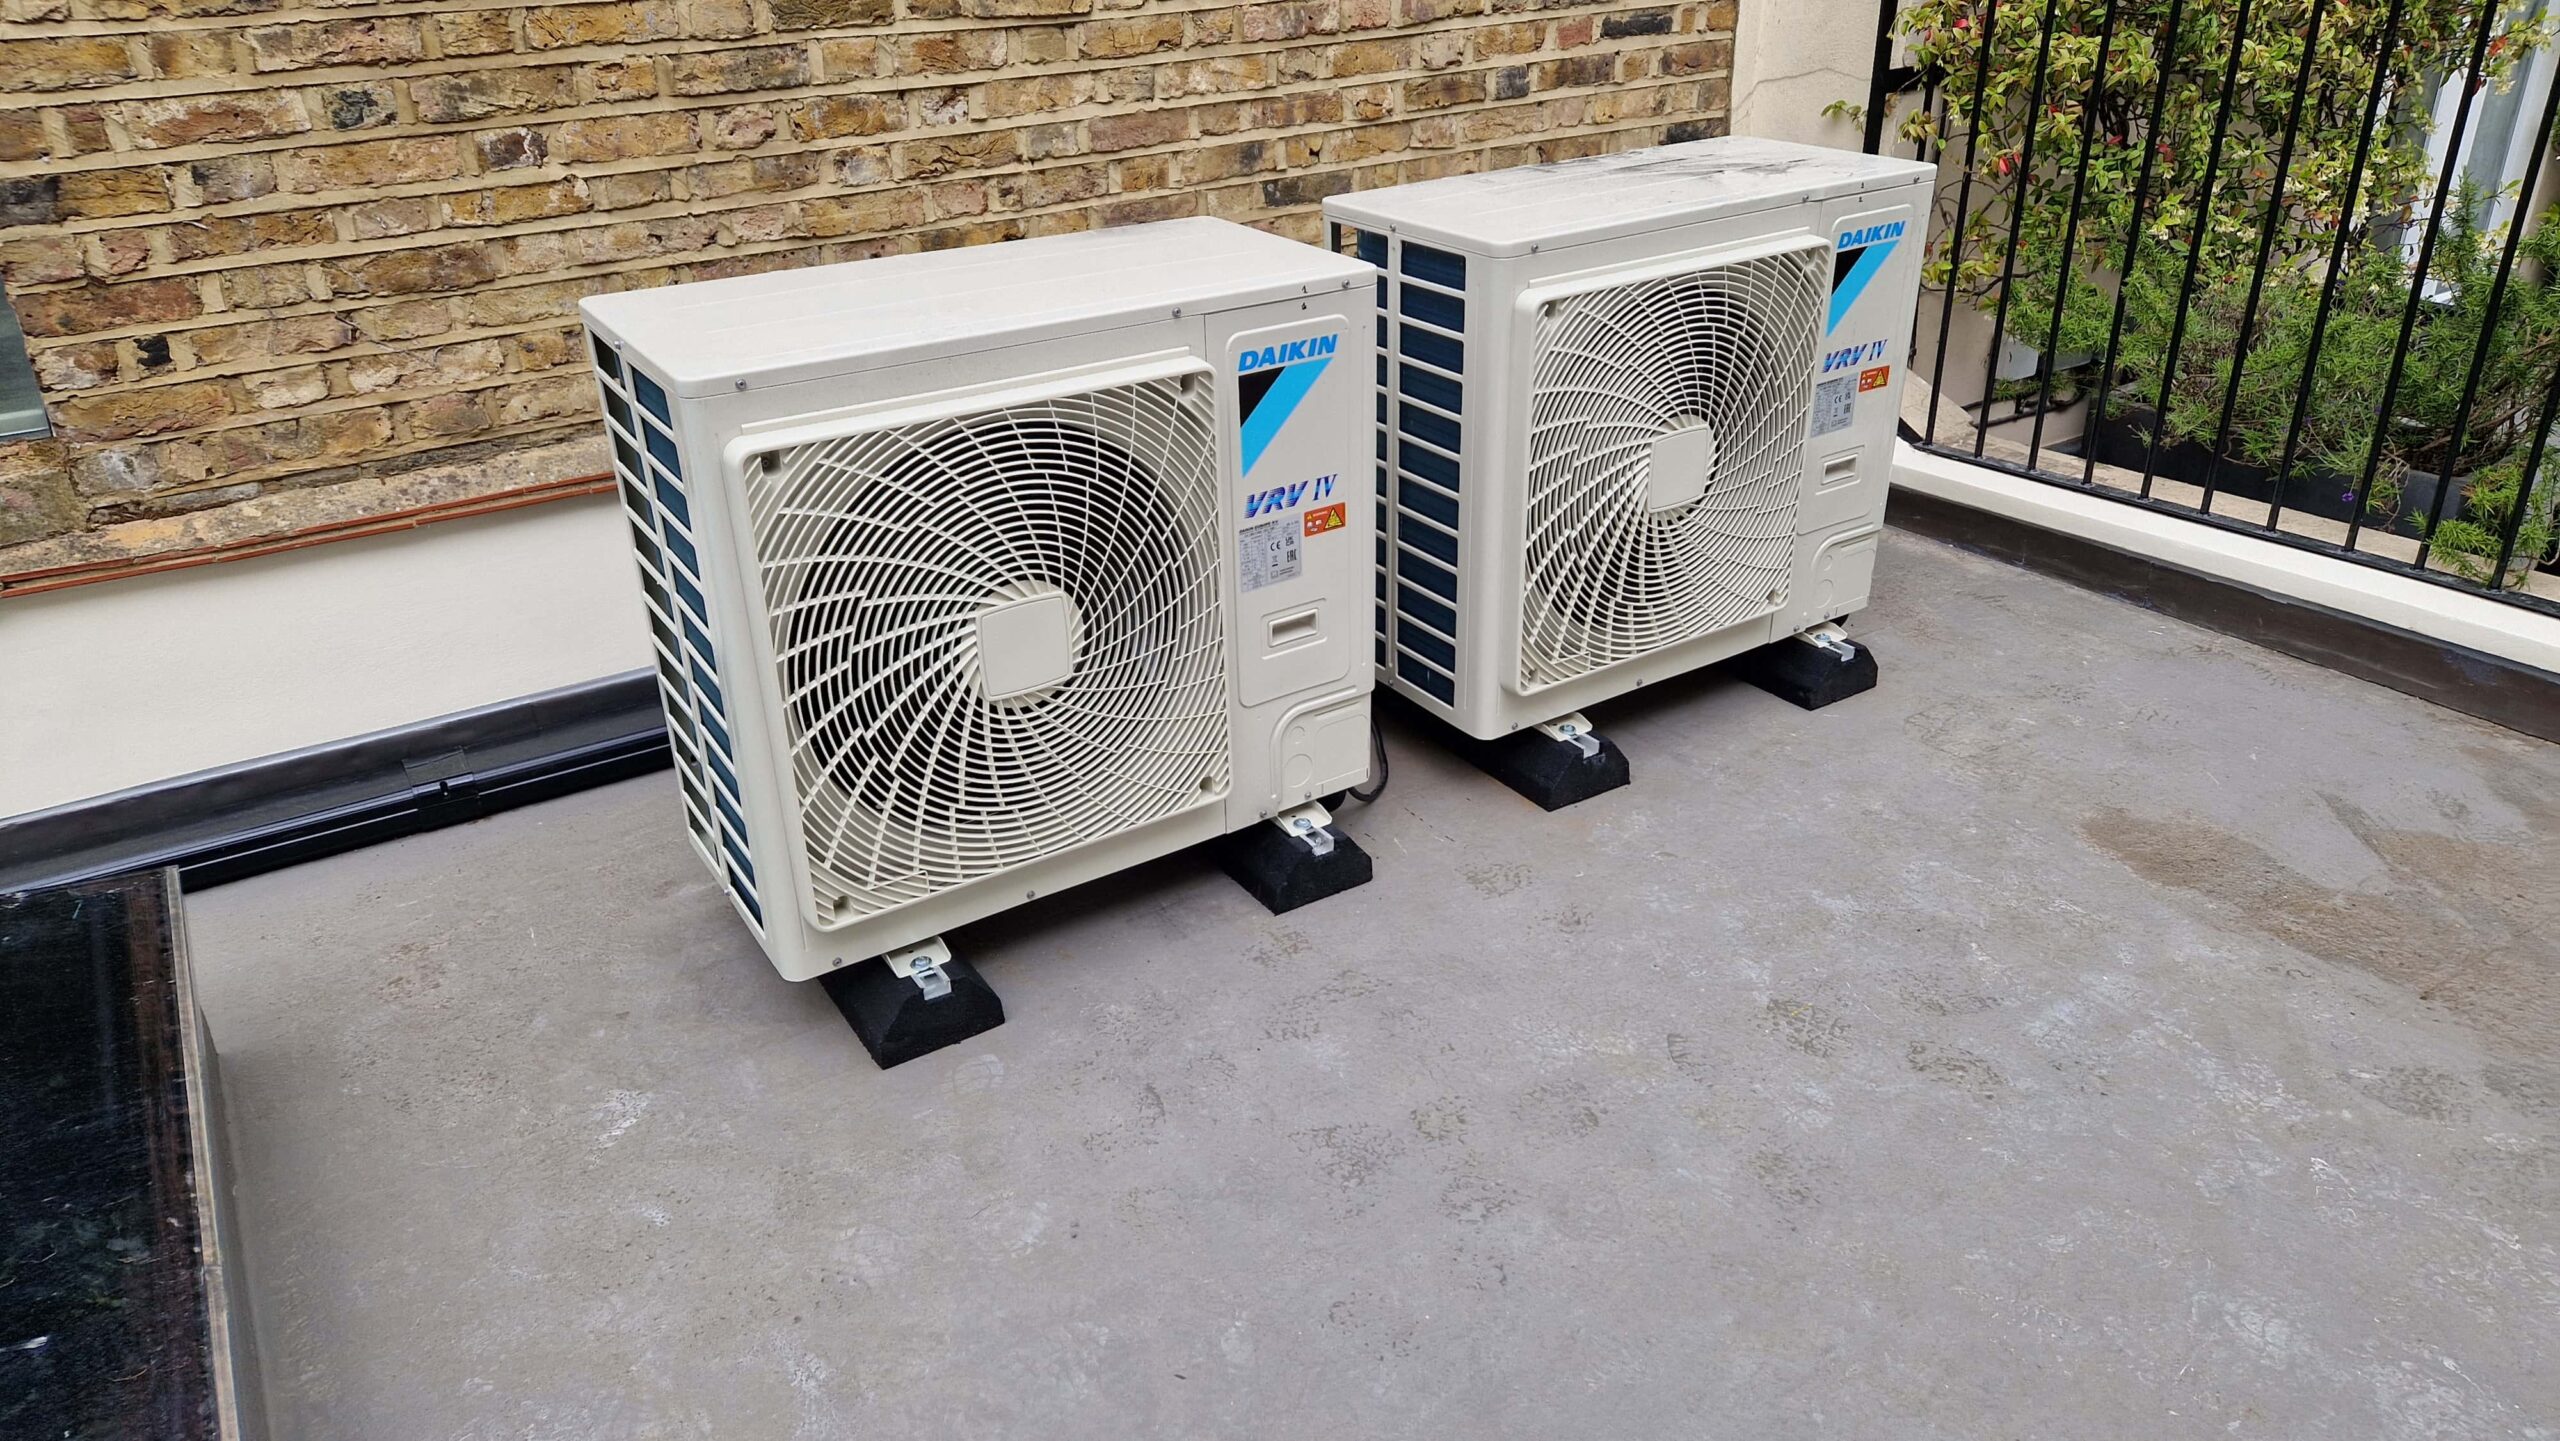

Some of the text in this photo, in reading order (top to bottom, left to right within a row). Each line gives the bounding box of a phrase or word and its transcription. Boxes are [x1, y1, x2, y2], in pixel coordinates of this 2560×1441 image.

[1838, 221, 1905, 249] DAIKIN
[1238, 334, 1338, 372] DAIKIN
[1822, 339, 1888, 373] VRV IV
[1244, 474, 1338, 519] VRV IV
